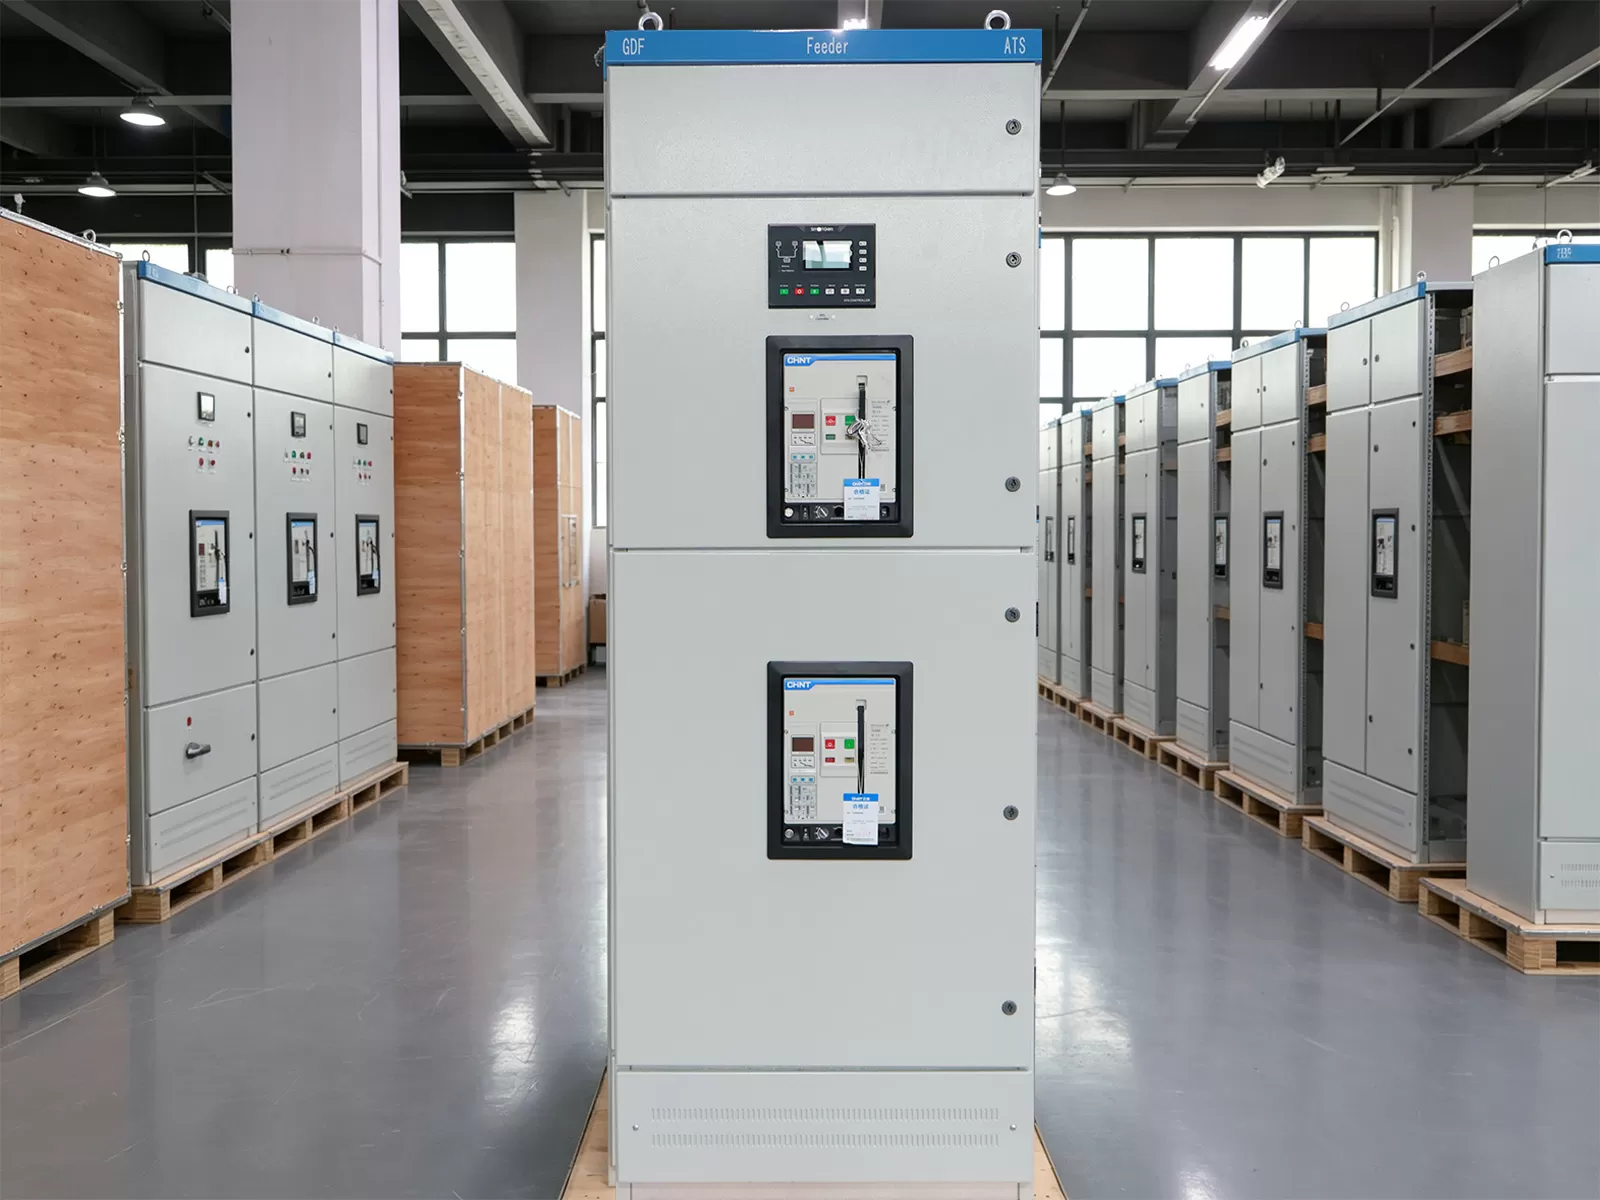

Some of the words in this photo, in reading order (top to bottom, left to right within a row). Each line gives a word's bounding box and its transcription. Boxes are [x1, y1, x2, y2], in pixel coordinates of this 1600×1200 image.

[622, 37, 645, 56] GDF
[807, 36, 849, 54] Feeder
[1003, 36, 1026, 55] ATS
[786, 356, 812, 364] CHNT
[786, 680, 812, 689] CHNT
